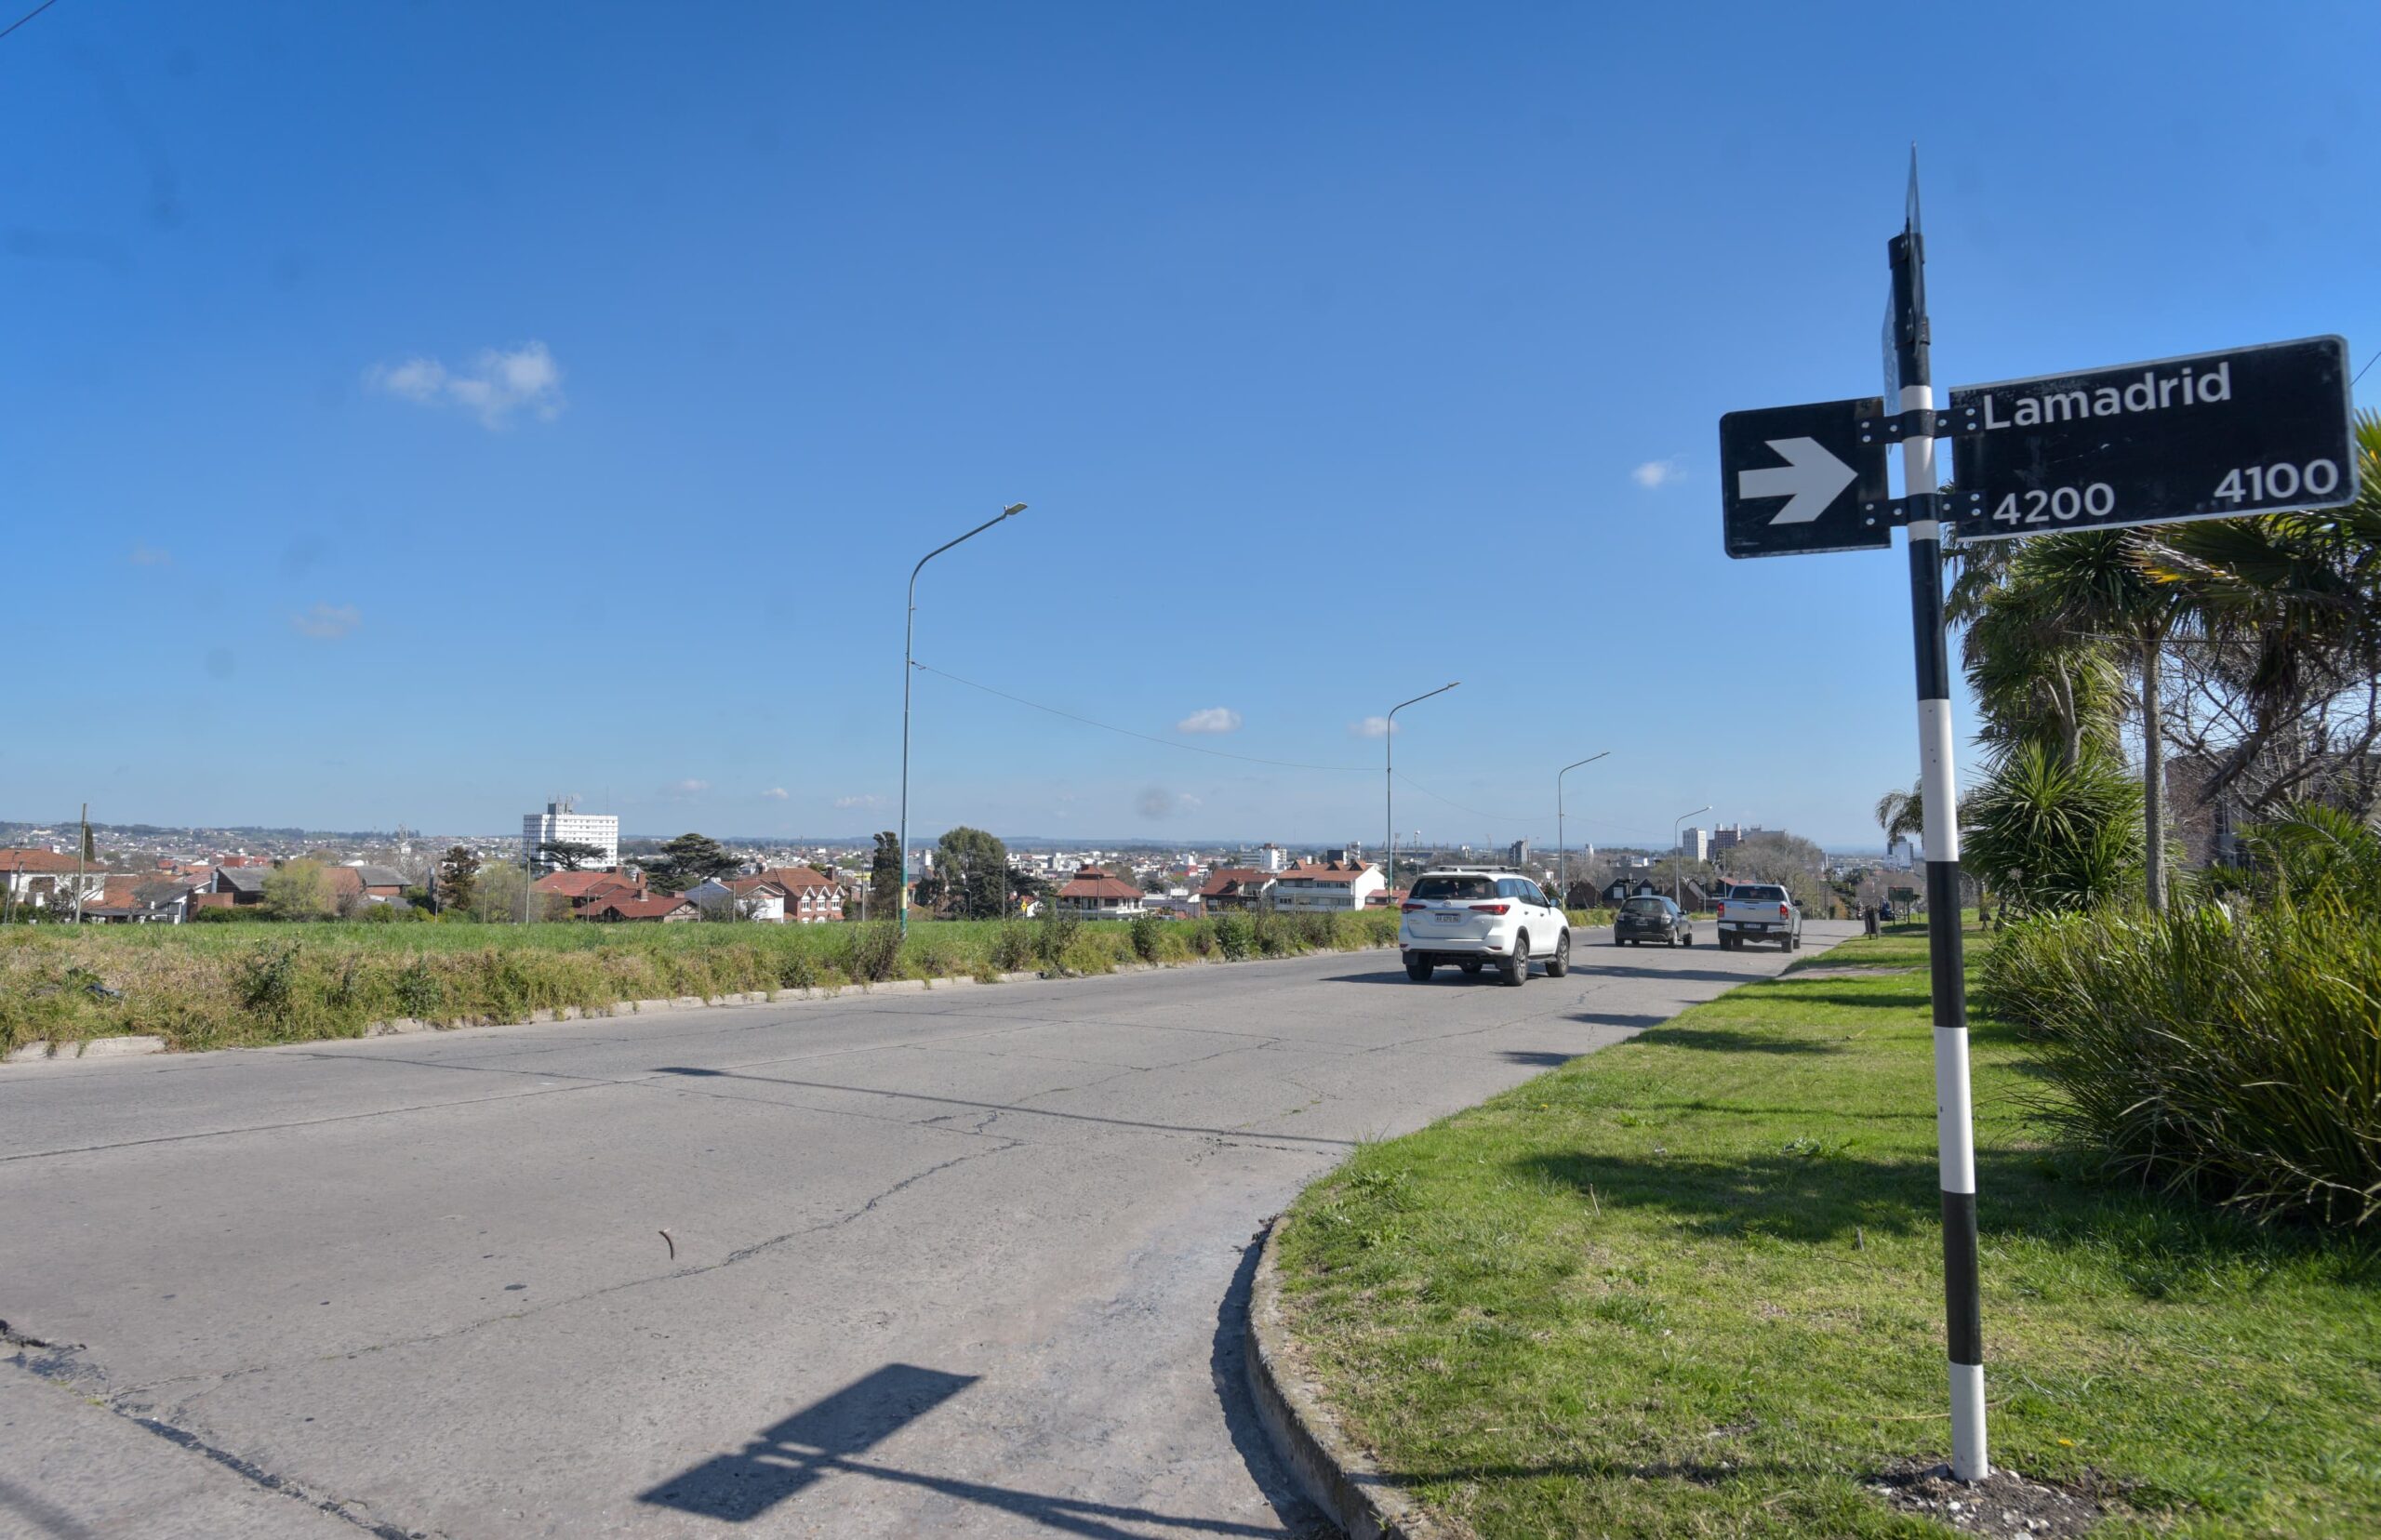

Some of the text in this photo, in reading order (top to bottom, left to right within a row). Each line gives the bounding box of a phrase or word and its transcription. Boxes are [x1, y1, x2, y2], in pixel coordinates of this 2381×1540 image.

[1984, 362, 2231, 430] Lamadrid
[2214, 459, 2338, 502] 4100
[1993, 483, 2115, 524] 4200
